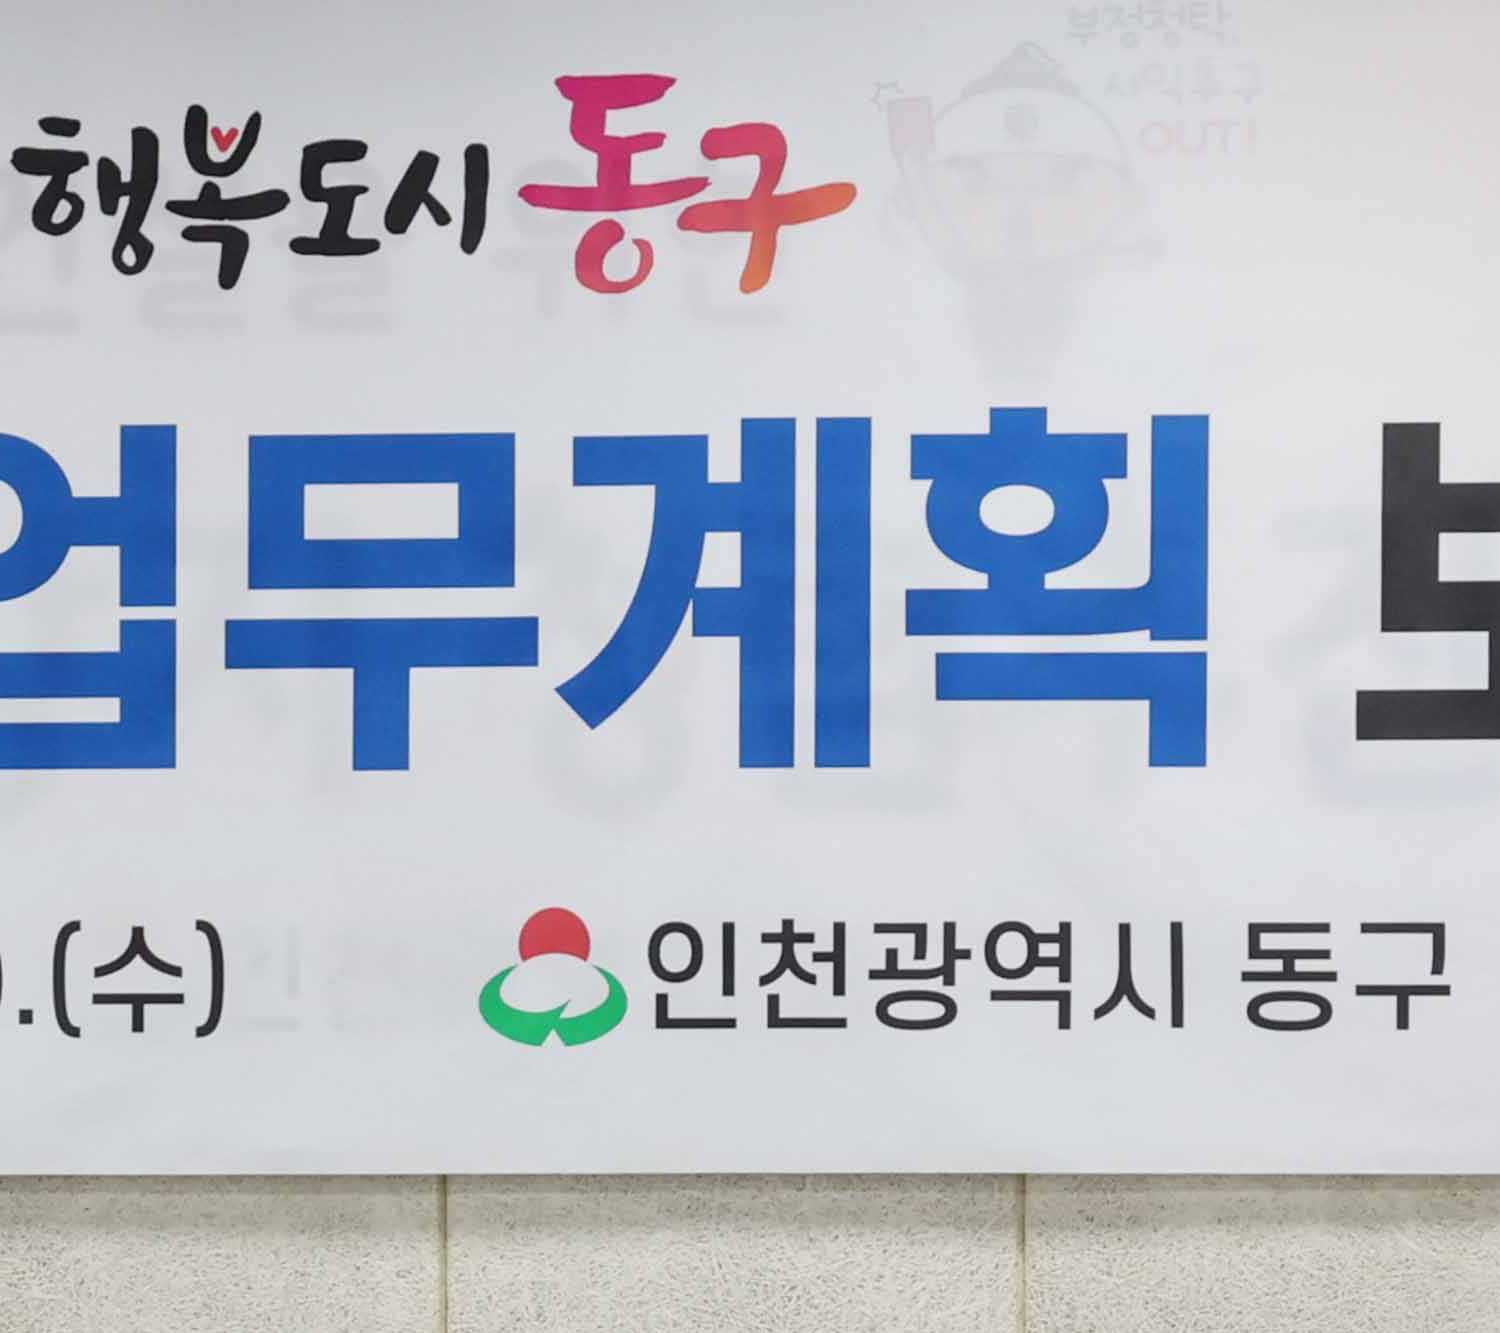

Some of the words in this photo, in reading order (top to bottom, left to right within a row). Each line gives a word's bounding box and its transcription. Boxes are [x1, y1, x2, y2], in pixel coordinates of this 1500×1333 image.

[10, 104, 490, 291] 행복도시
[517, 73, 858, 294] 동구
[646, 918, 1185, 1032] 인천광역시
[1241, 921, 1452, 1032] 동구
